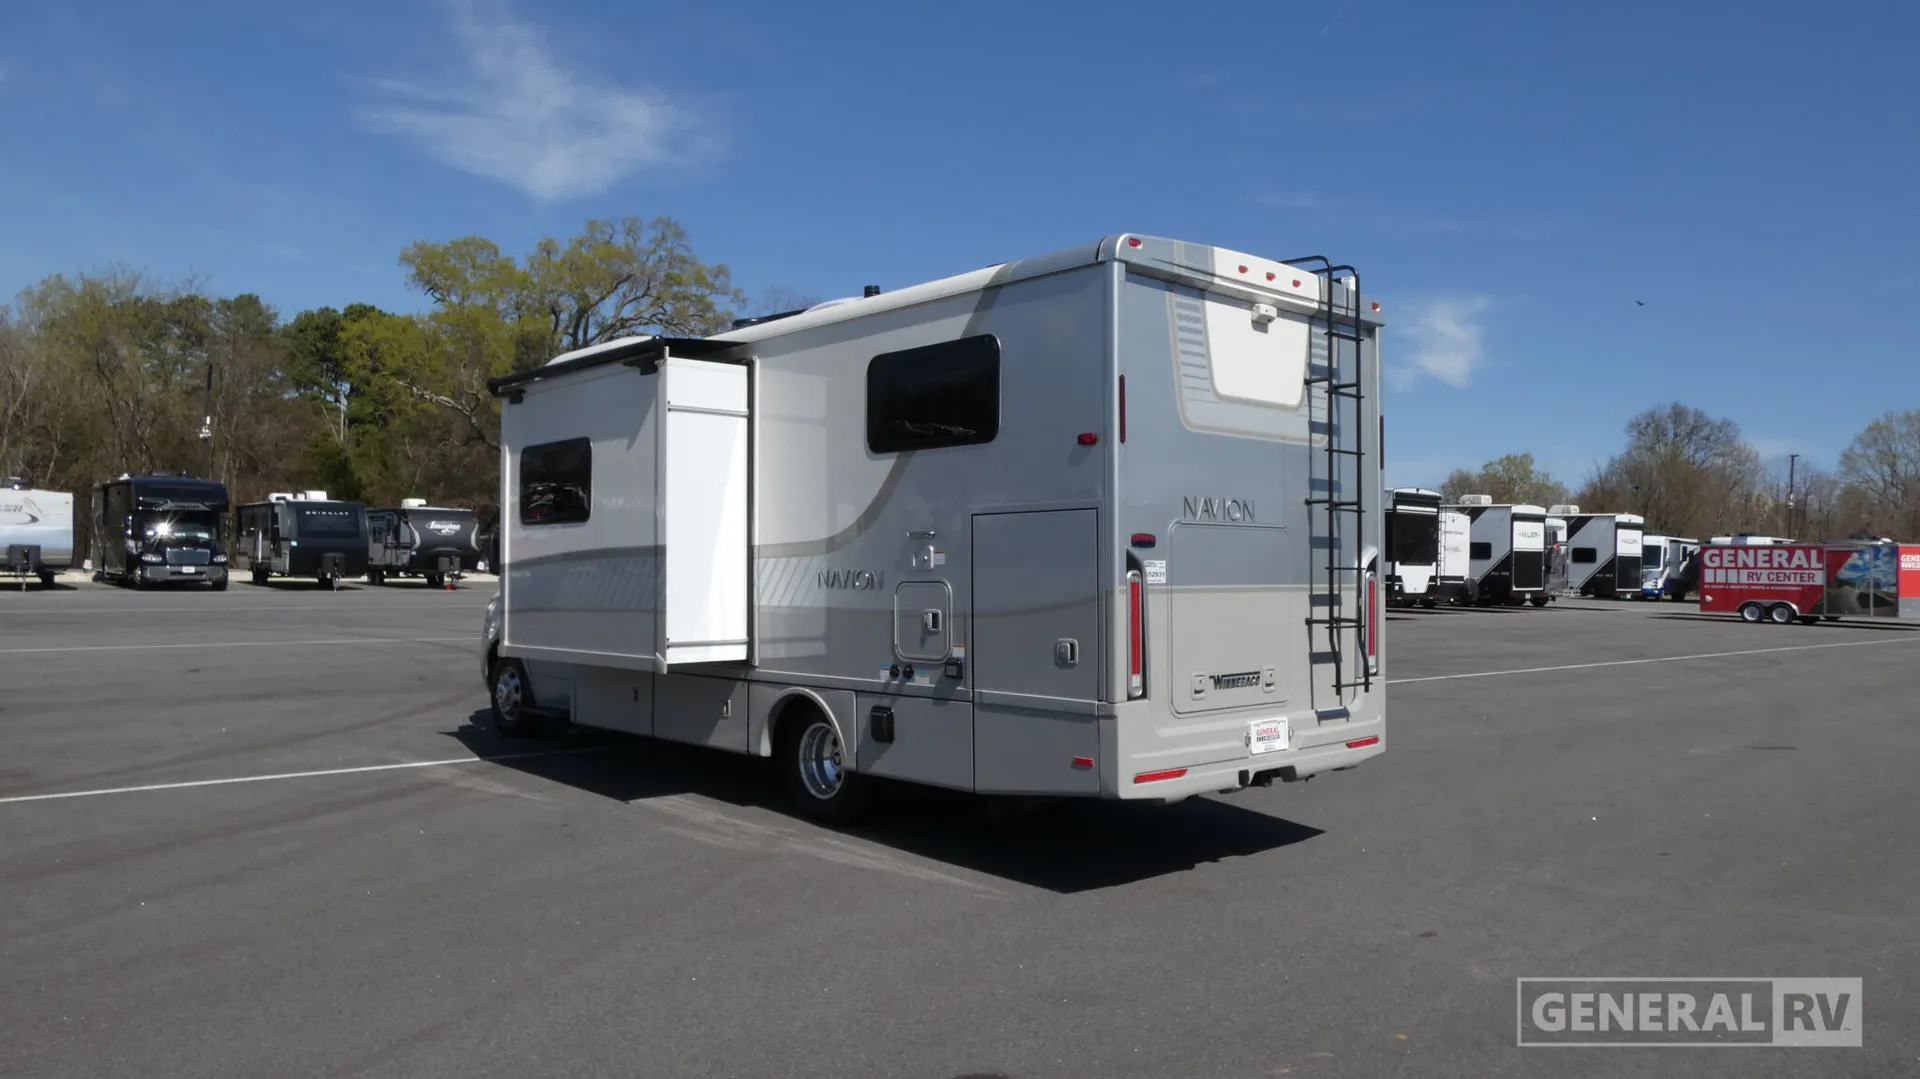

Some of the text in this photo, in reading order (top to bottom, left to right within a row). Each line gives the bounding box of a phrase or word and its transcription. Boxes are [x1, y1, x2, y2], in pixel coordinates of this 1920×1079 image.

[1183, 496, 1255, 521] NAVION
[429, 520, 461, 533] Imagine
[1703, 549, 1823, 568] GENERAL
[816, 569, 884, 590] NAVION
[1747, 571, 1816, 583] RV CENTER
